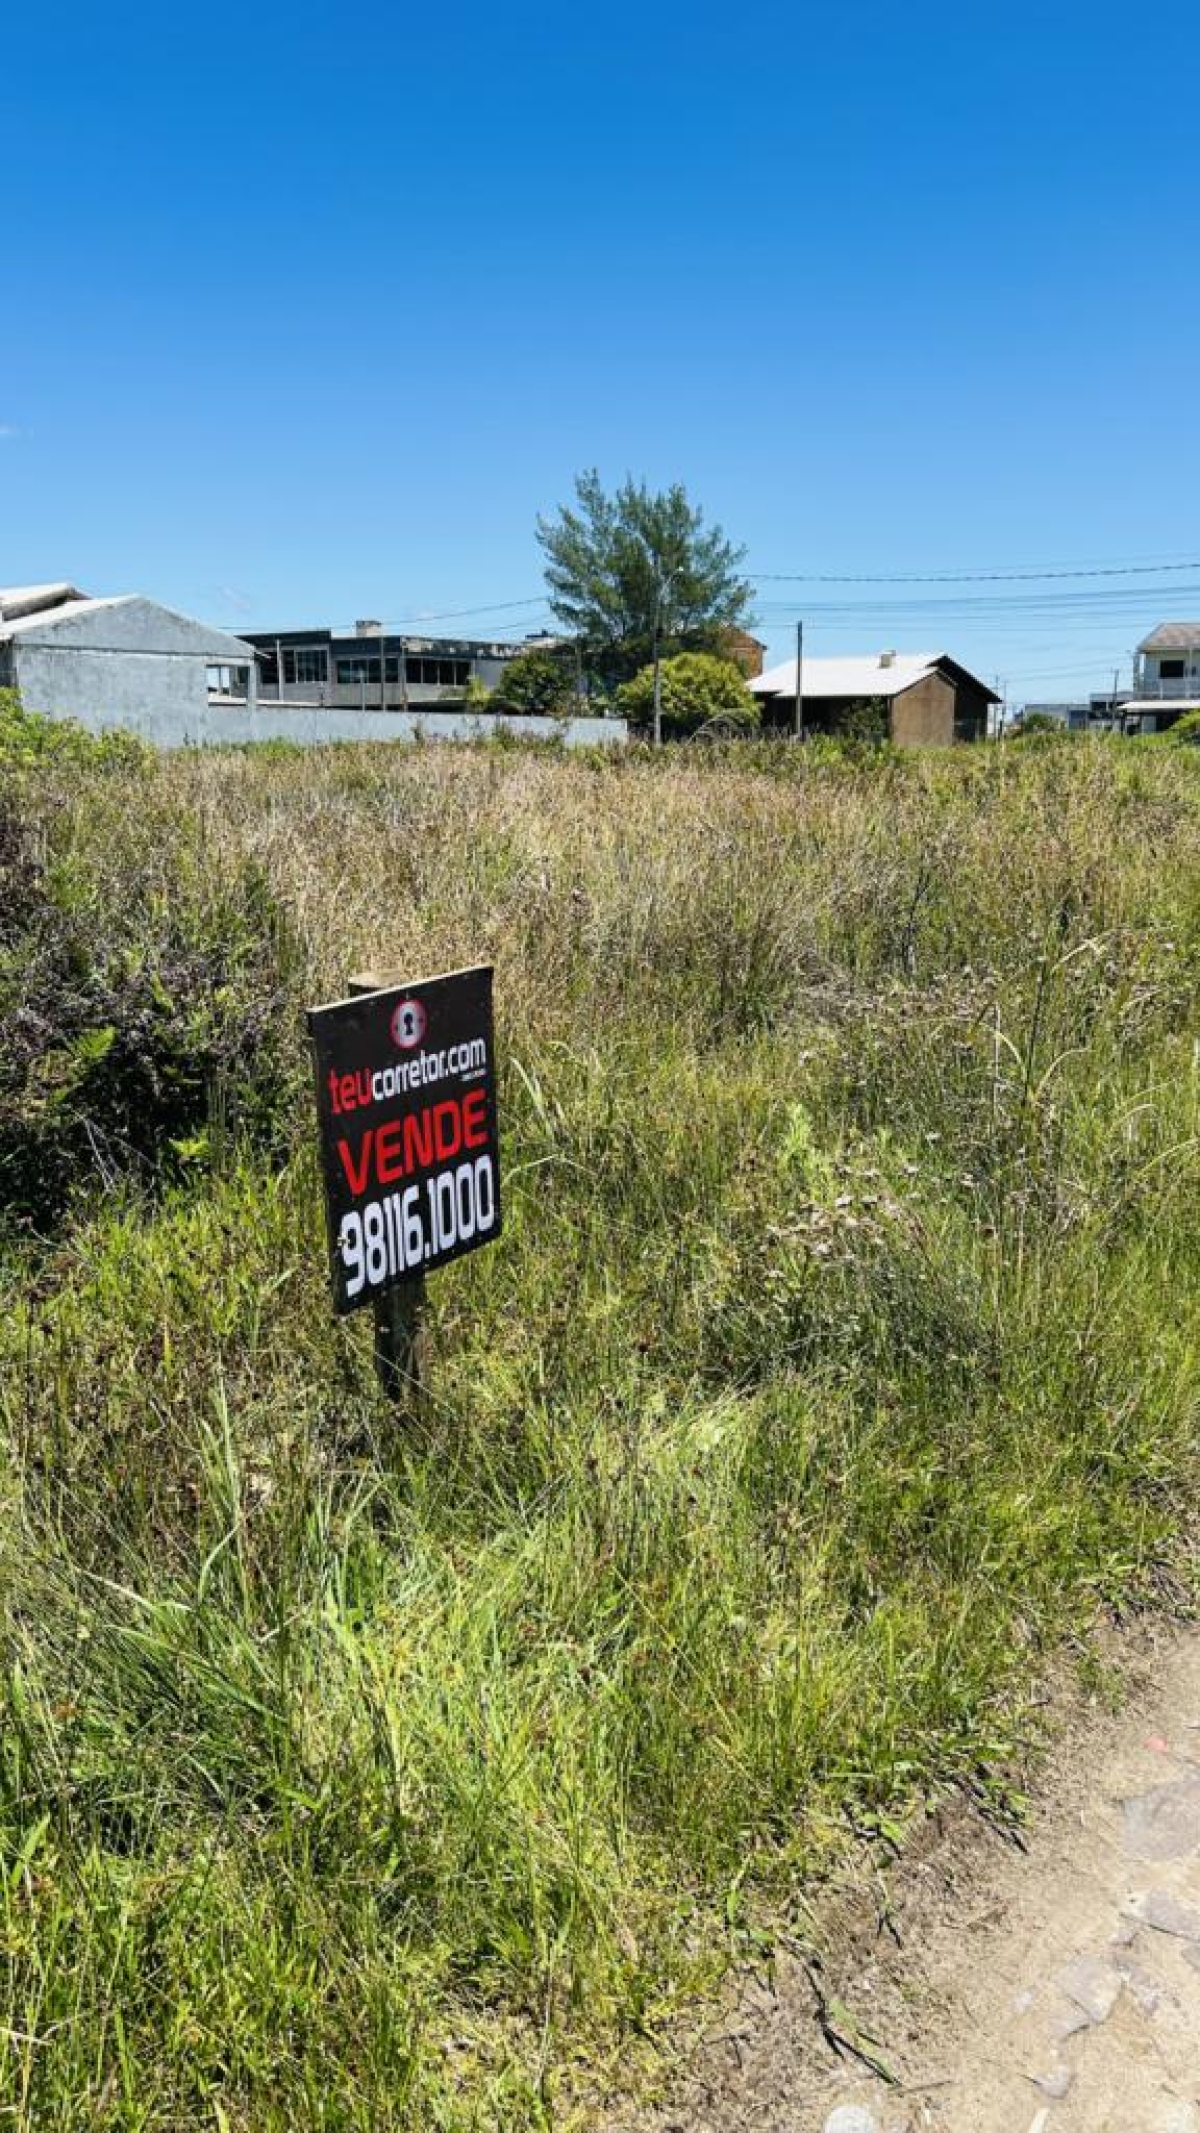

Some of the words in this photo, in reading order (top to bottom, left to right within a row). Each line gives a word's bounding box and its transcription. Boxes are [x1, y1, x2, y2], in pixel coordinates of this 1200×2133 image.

[329, 1038, 486, 1113] teucorretor.com
[337, 1088, 489, 1195] VENDE
[340, 1155, 495, 1297] 98116.1000
